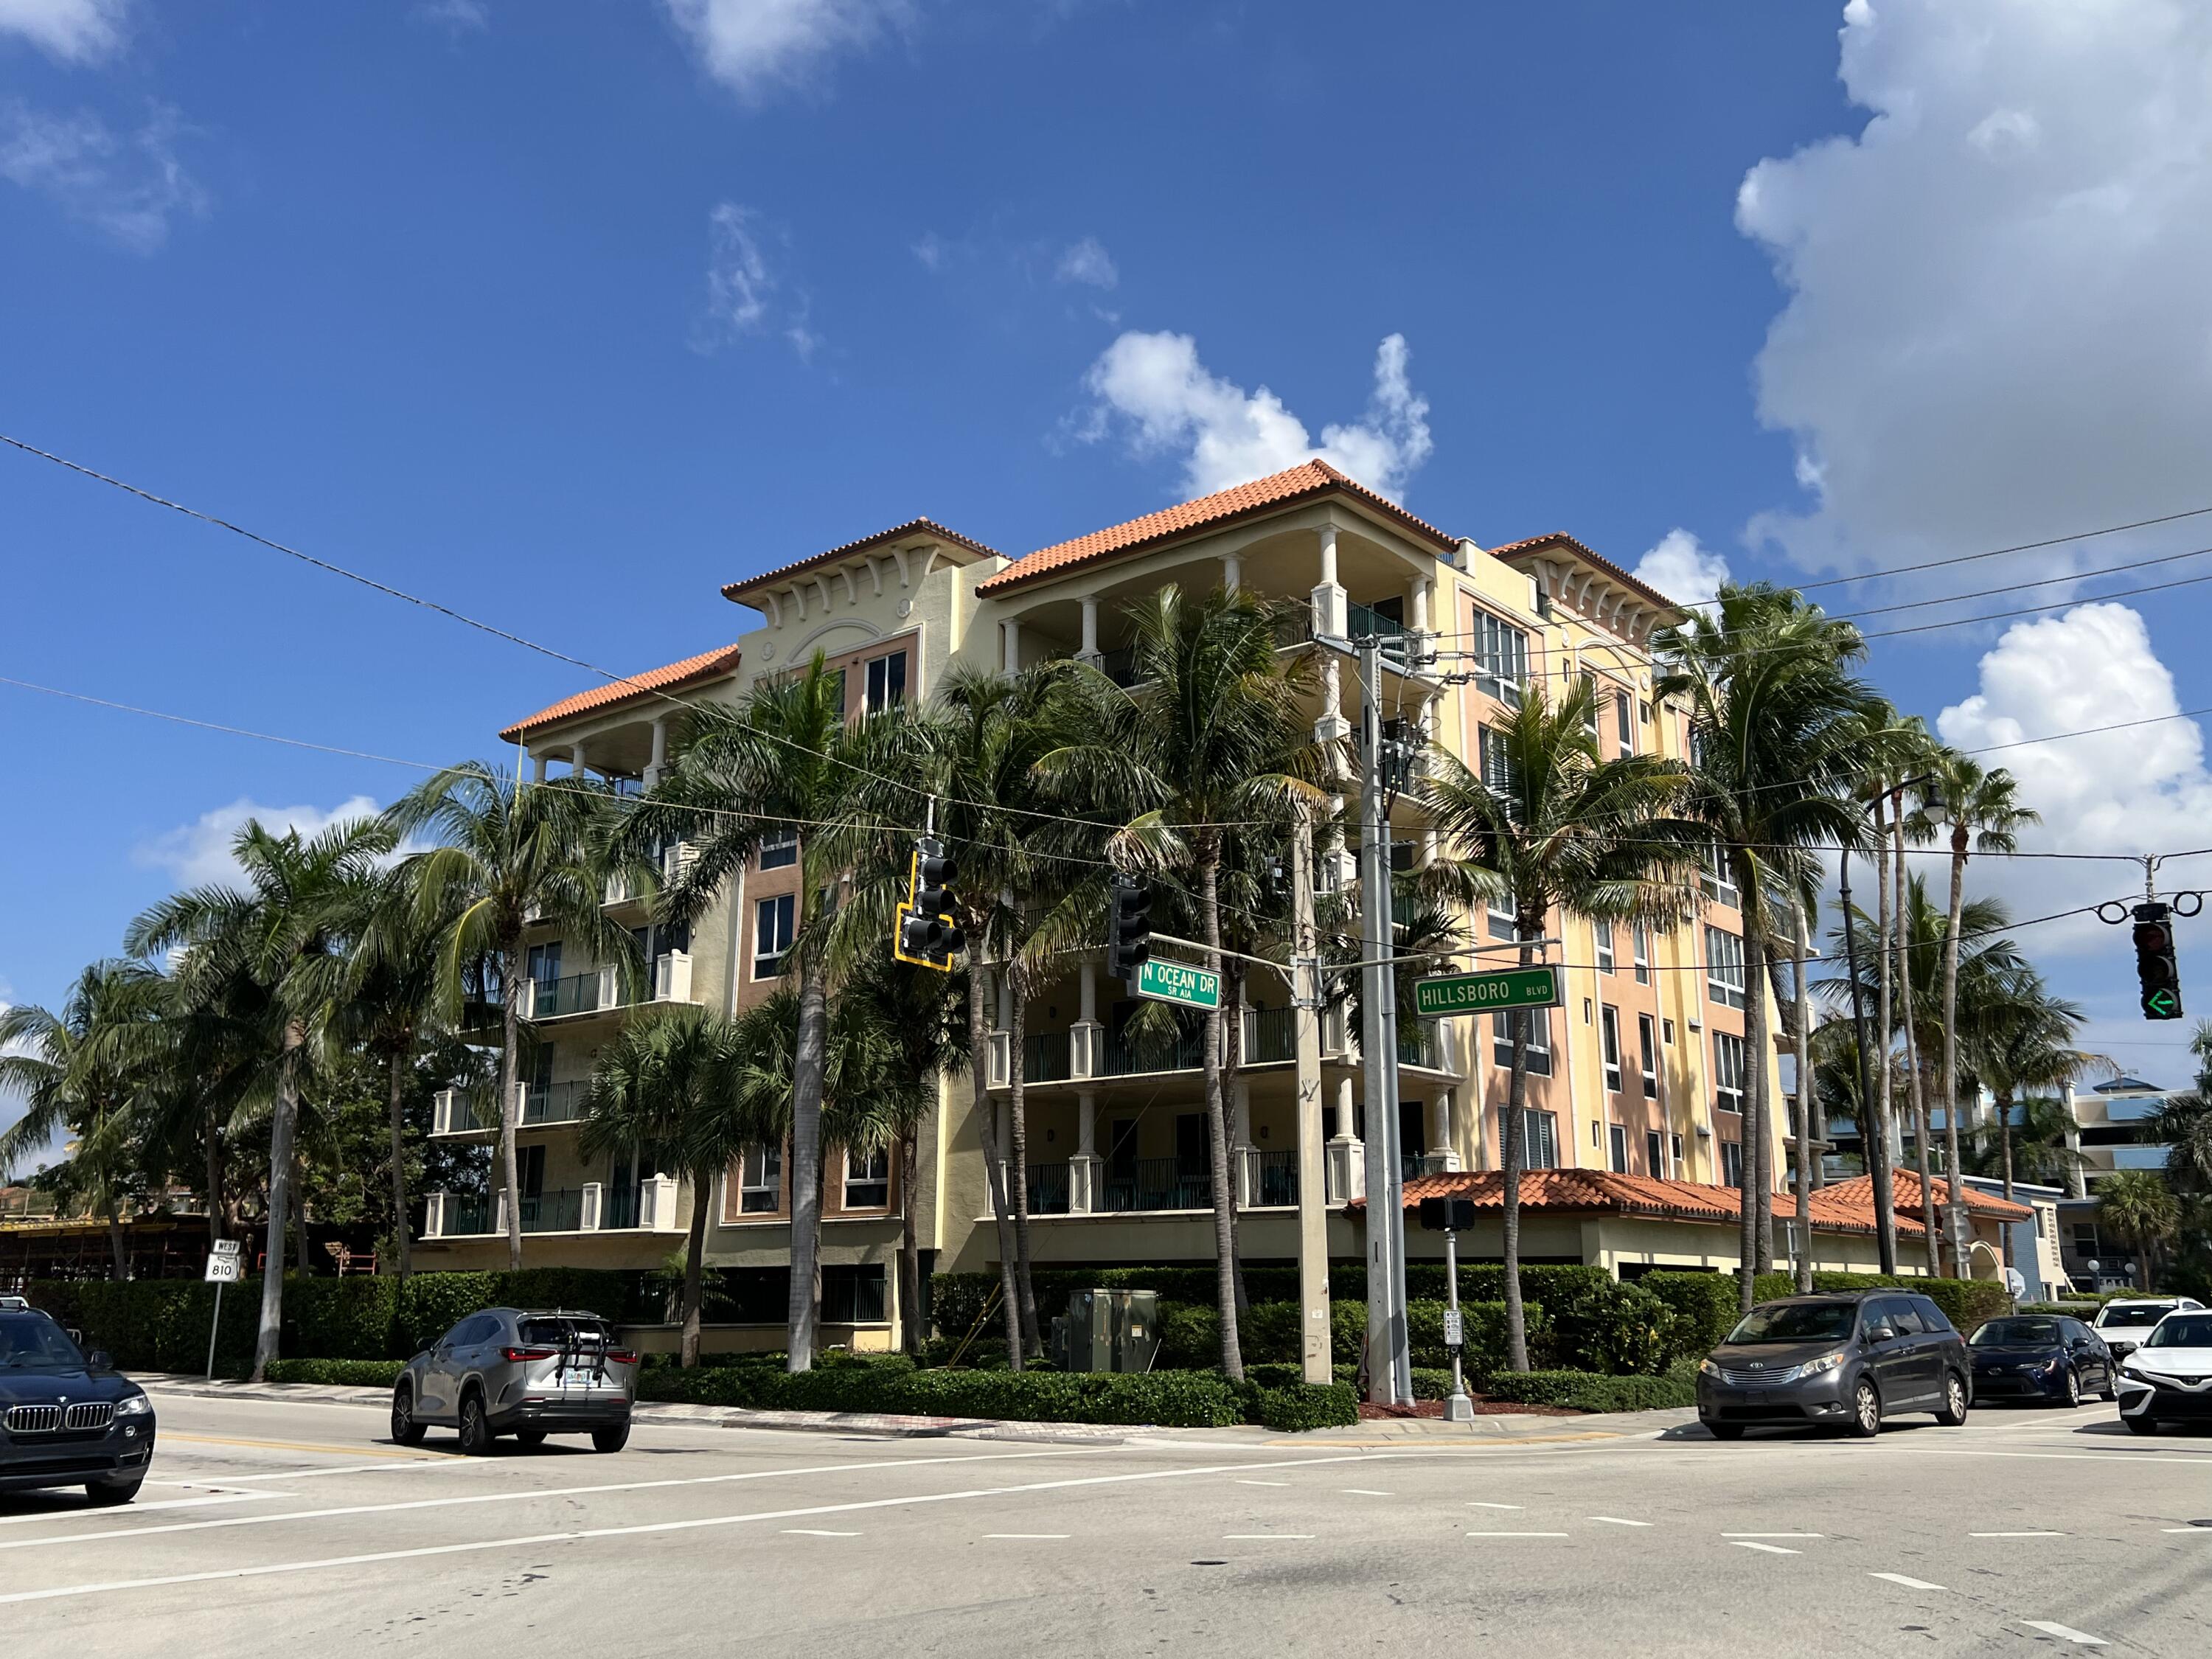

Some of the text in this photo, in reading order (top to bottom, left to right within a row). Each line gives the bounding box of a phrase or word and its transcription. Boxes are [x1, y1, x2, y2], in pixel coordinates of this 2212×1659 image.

[1144, 963, 1214, 994] N OCEAN DR
[1167, 986, 1177, 995] SR
[1422, 981, 1548, 1006] HILLSBORO BLVD
[218, 1242, 236, 1251] WEST
[212, 1265, 232, 1275] 810
